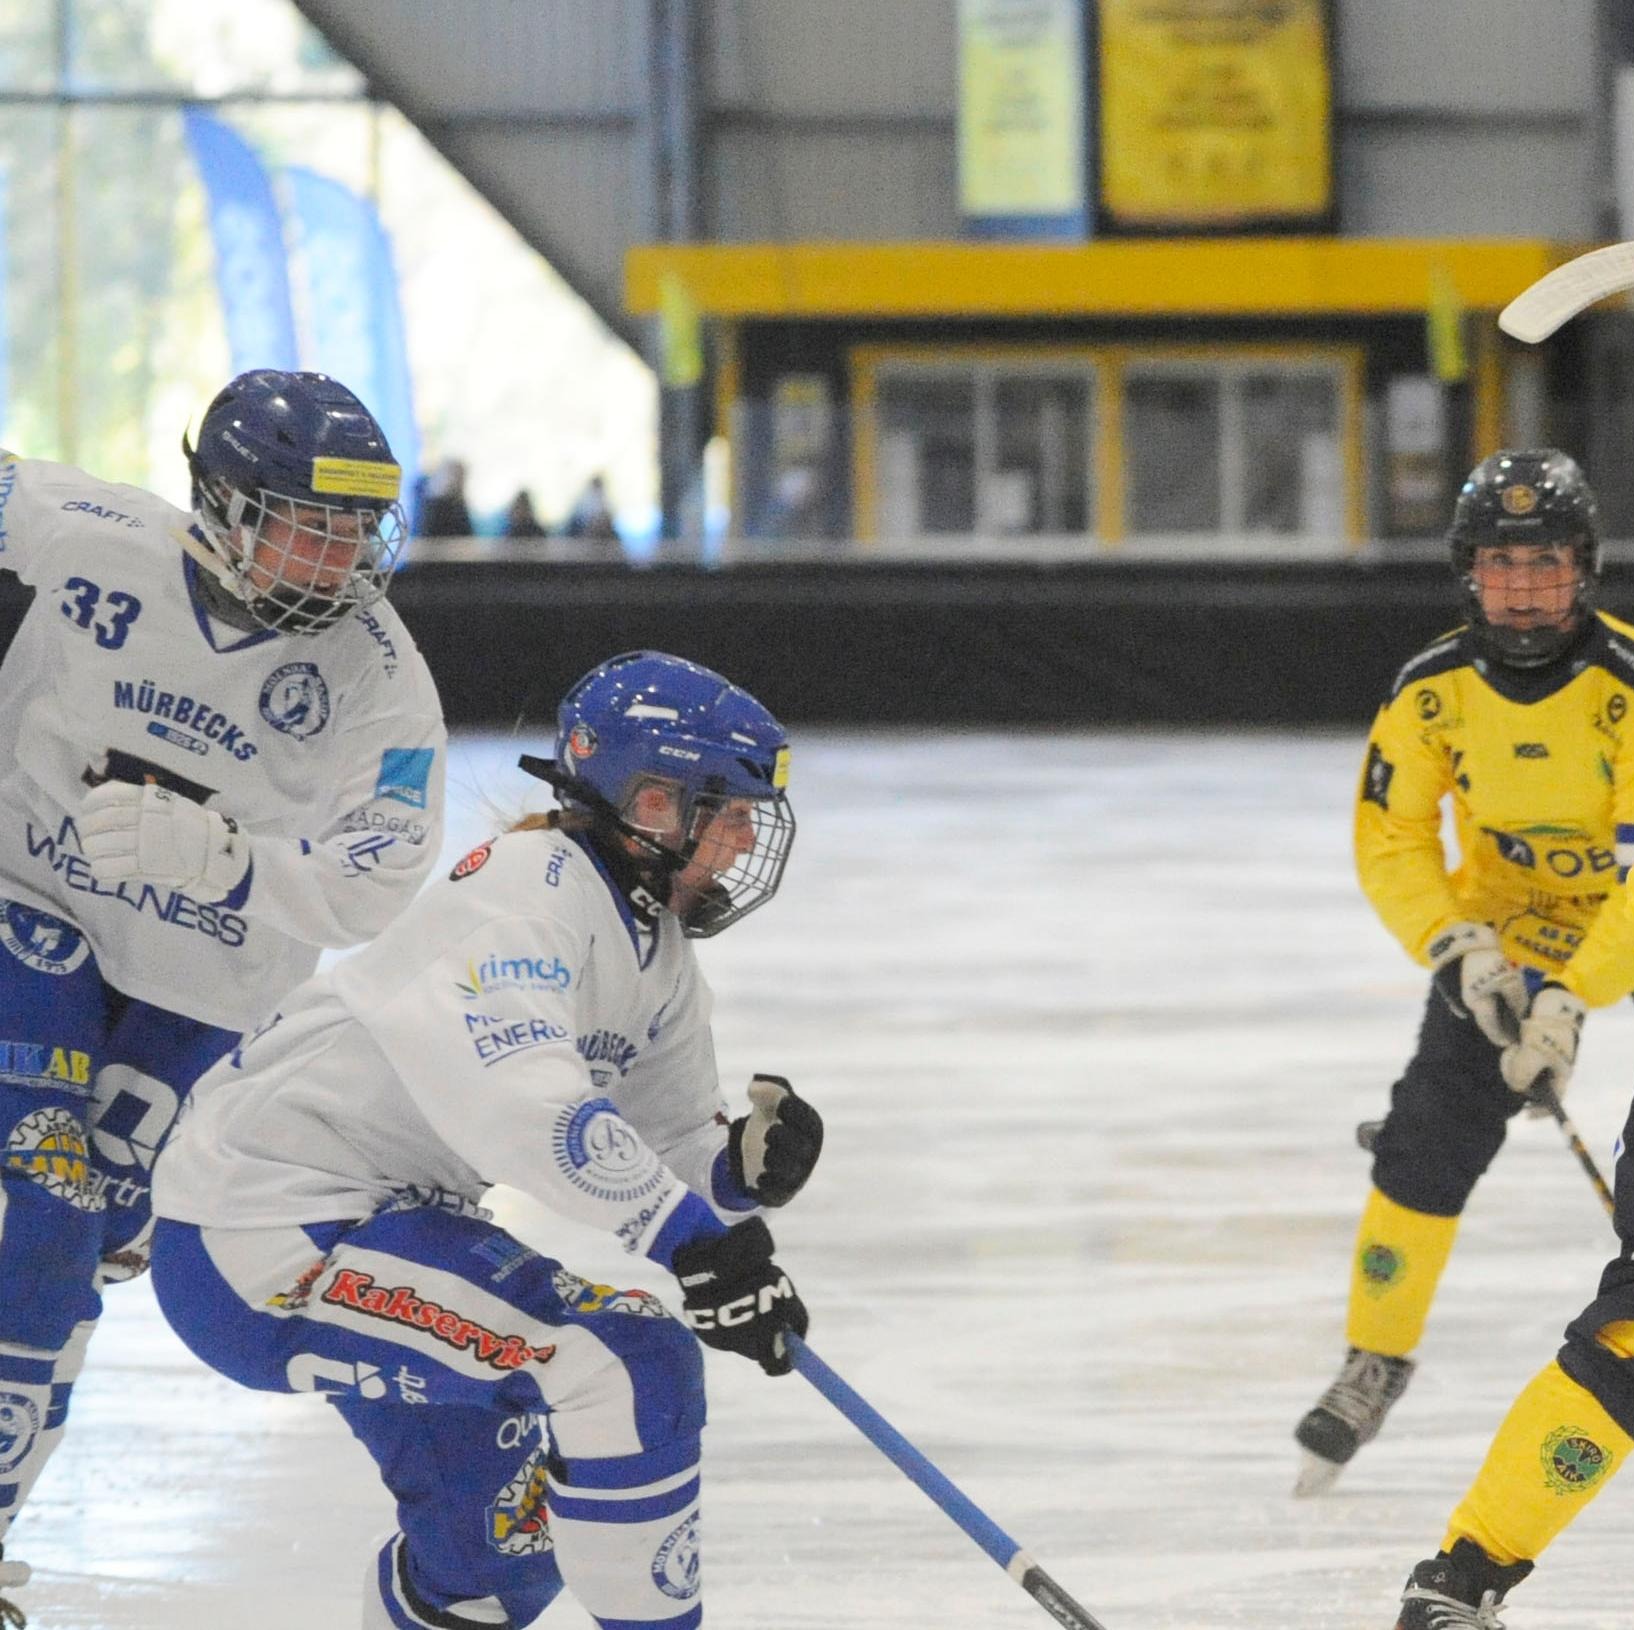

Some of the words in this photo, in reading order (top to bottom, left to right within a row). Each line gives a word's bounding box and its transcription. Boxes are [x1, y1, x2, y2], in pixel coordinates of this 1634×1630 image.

[61, 500, 129, 525] CRAFT
[61, 576, 142, 650] 33
[113, 679, 258, 762] MÜRBECKS
[659, 745, 701, 762] CCM
[27, 822, 248, 947] WELLNESS
[545, 852, 567, 887] CRA
[684, 1276, 794, 1330] CCM
